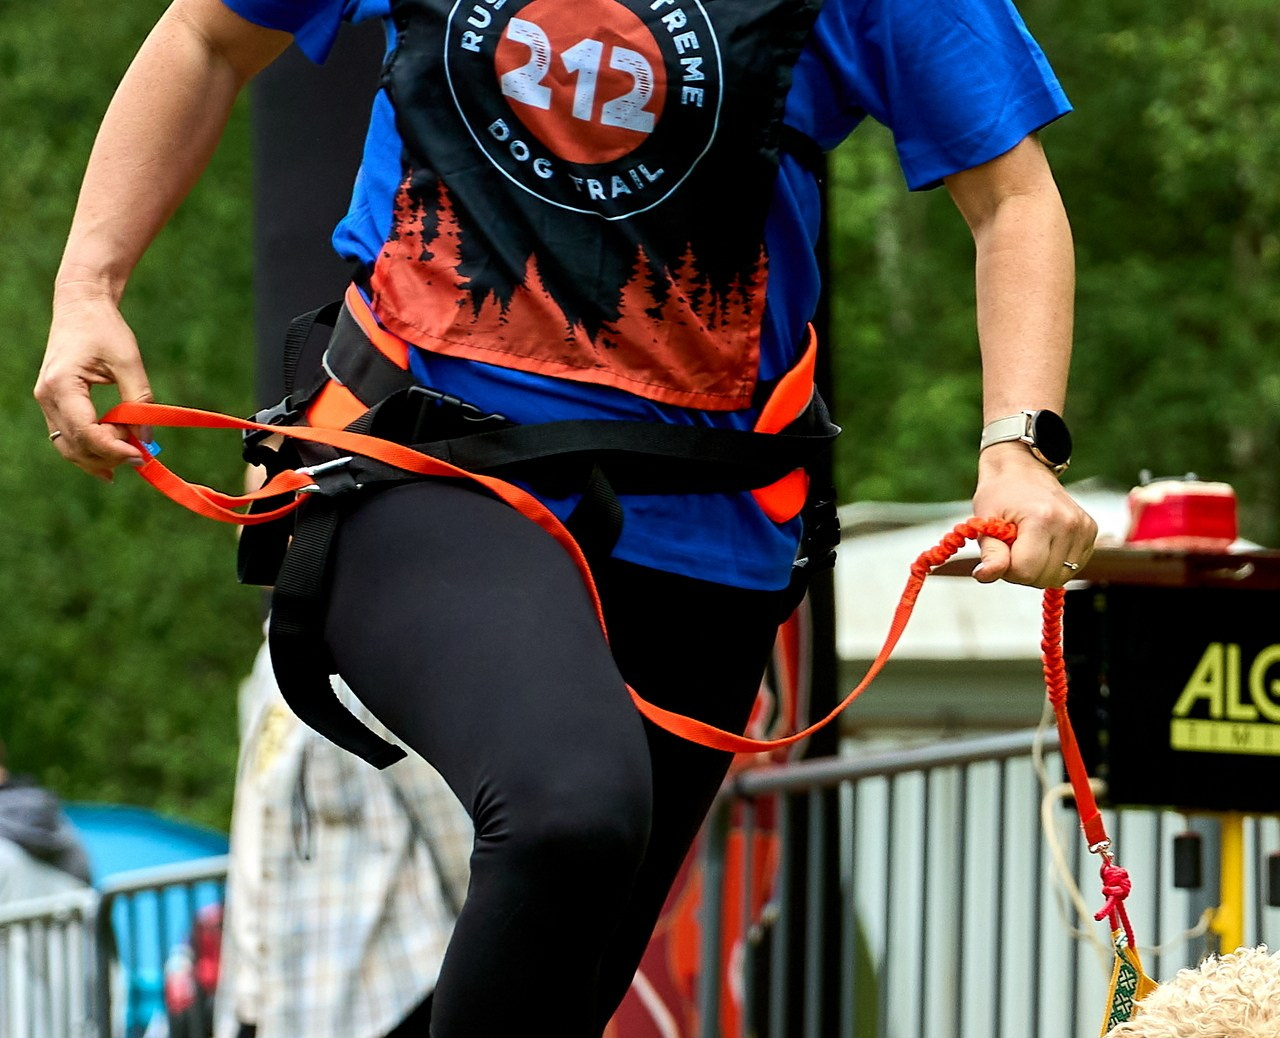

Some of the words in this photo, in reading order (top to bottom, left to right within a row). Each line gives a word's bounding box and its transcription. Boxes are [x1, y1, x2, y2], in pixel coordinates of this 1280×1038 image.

[500, 16, 657, 134] 212
[487, 118, 553, 179] DOG
[567, 163, 665, 201] TRAIL
